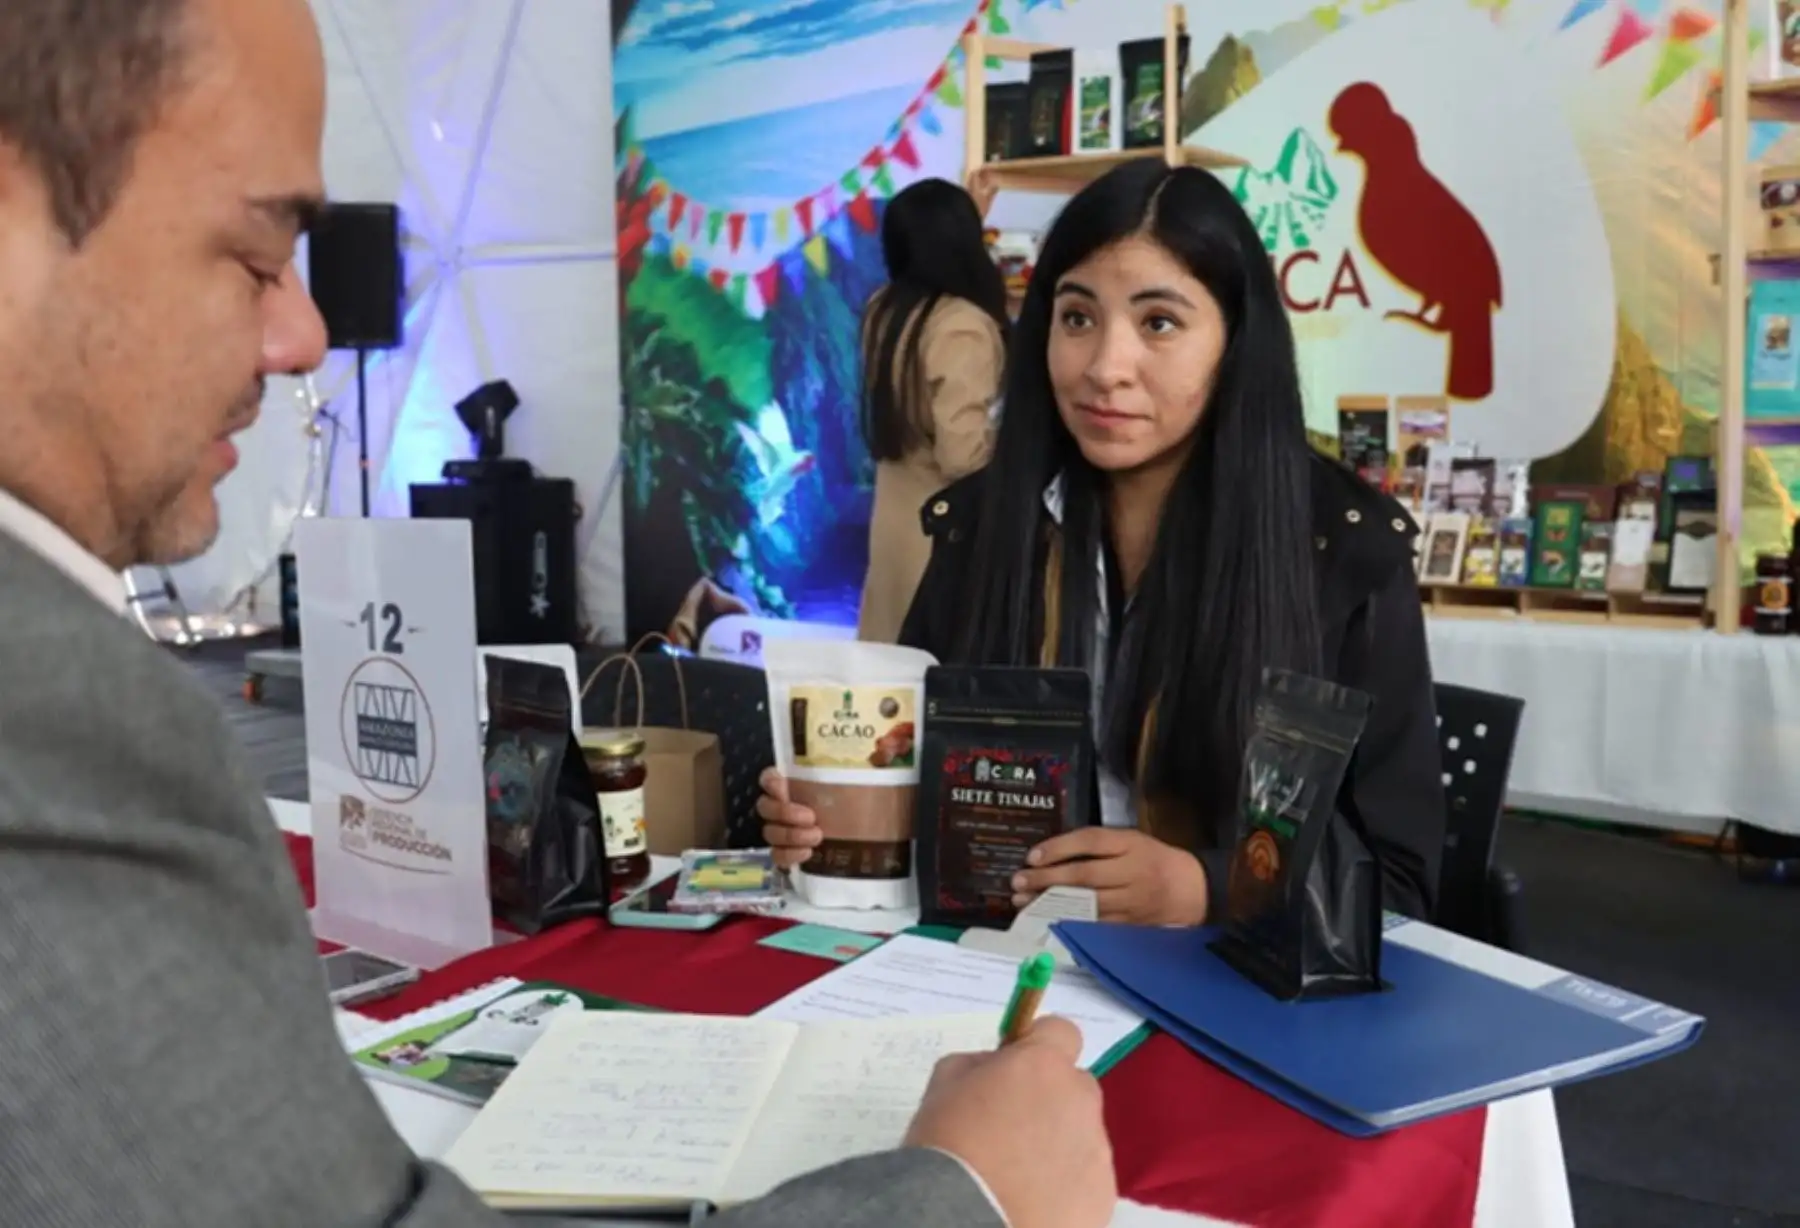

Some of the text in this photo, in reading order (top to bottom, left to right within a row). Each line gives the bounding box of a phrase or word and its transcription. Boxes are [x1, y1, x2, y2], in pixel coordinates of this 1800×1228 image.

[1268, 247, 1371, 313] CA
[360, 602, 404, 654] 12
[818, 723, 876, 739] CACAO
[951, 788, 1056, 810] SIETE TINAJAS
[373, 831, 452, 861] PRODUCCIÓN
